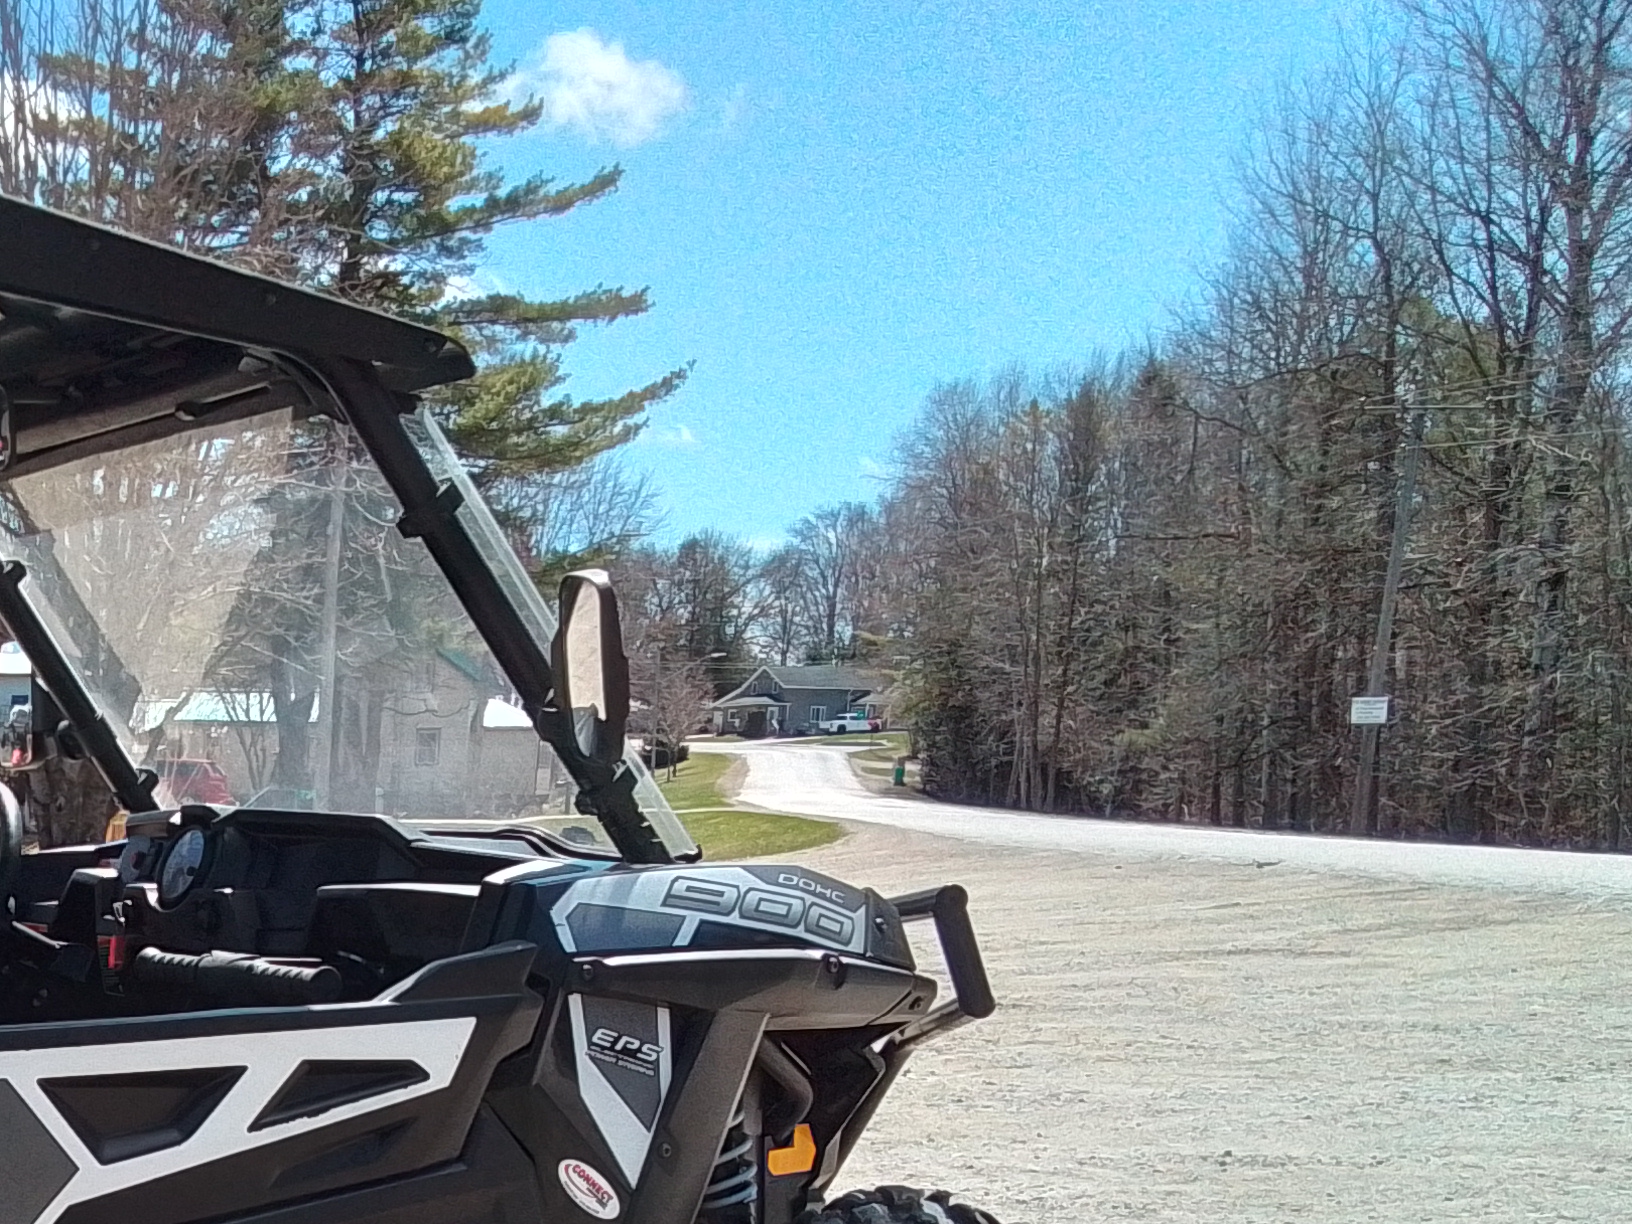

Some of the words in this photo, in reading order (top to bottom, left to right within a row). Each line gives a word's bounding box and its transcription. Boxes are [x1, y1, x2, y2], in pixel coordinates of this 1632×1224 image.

[777, 873, 845, 904] DOHC
[660, 876, 854, 946] 900
[591, 1028, 663, 1062] EPS
[571, 1164, 614, 1204] CONNECT
